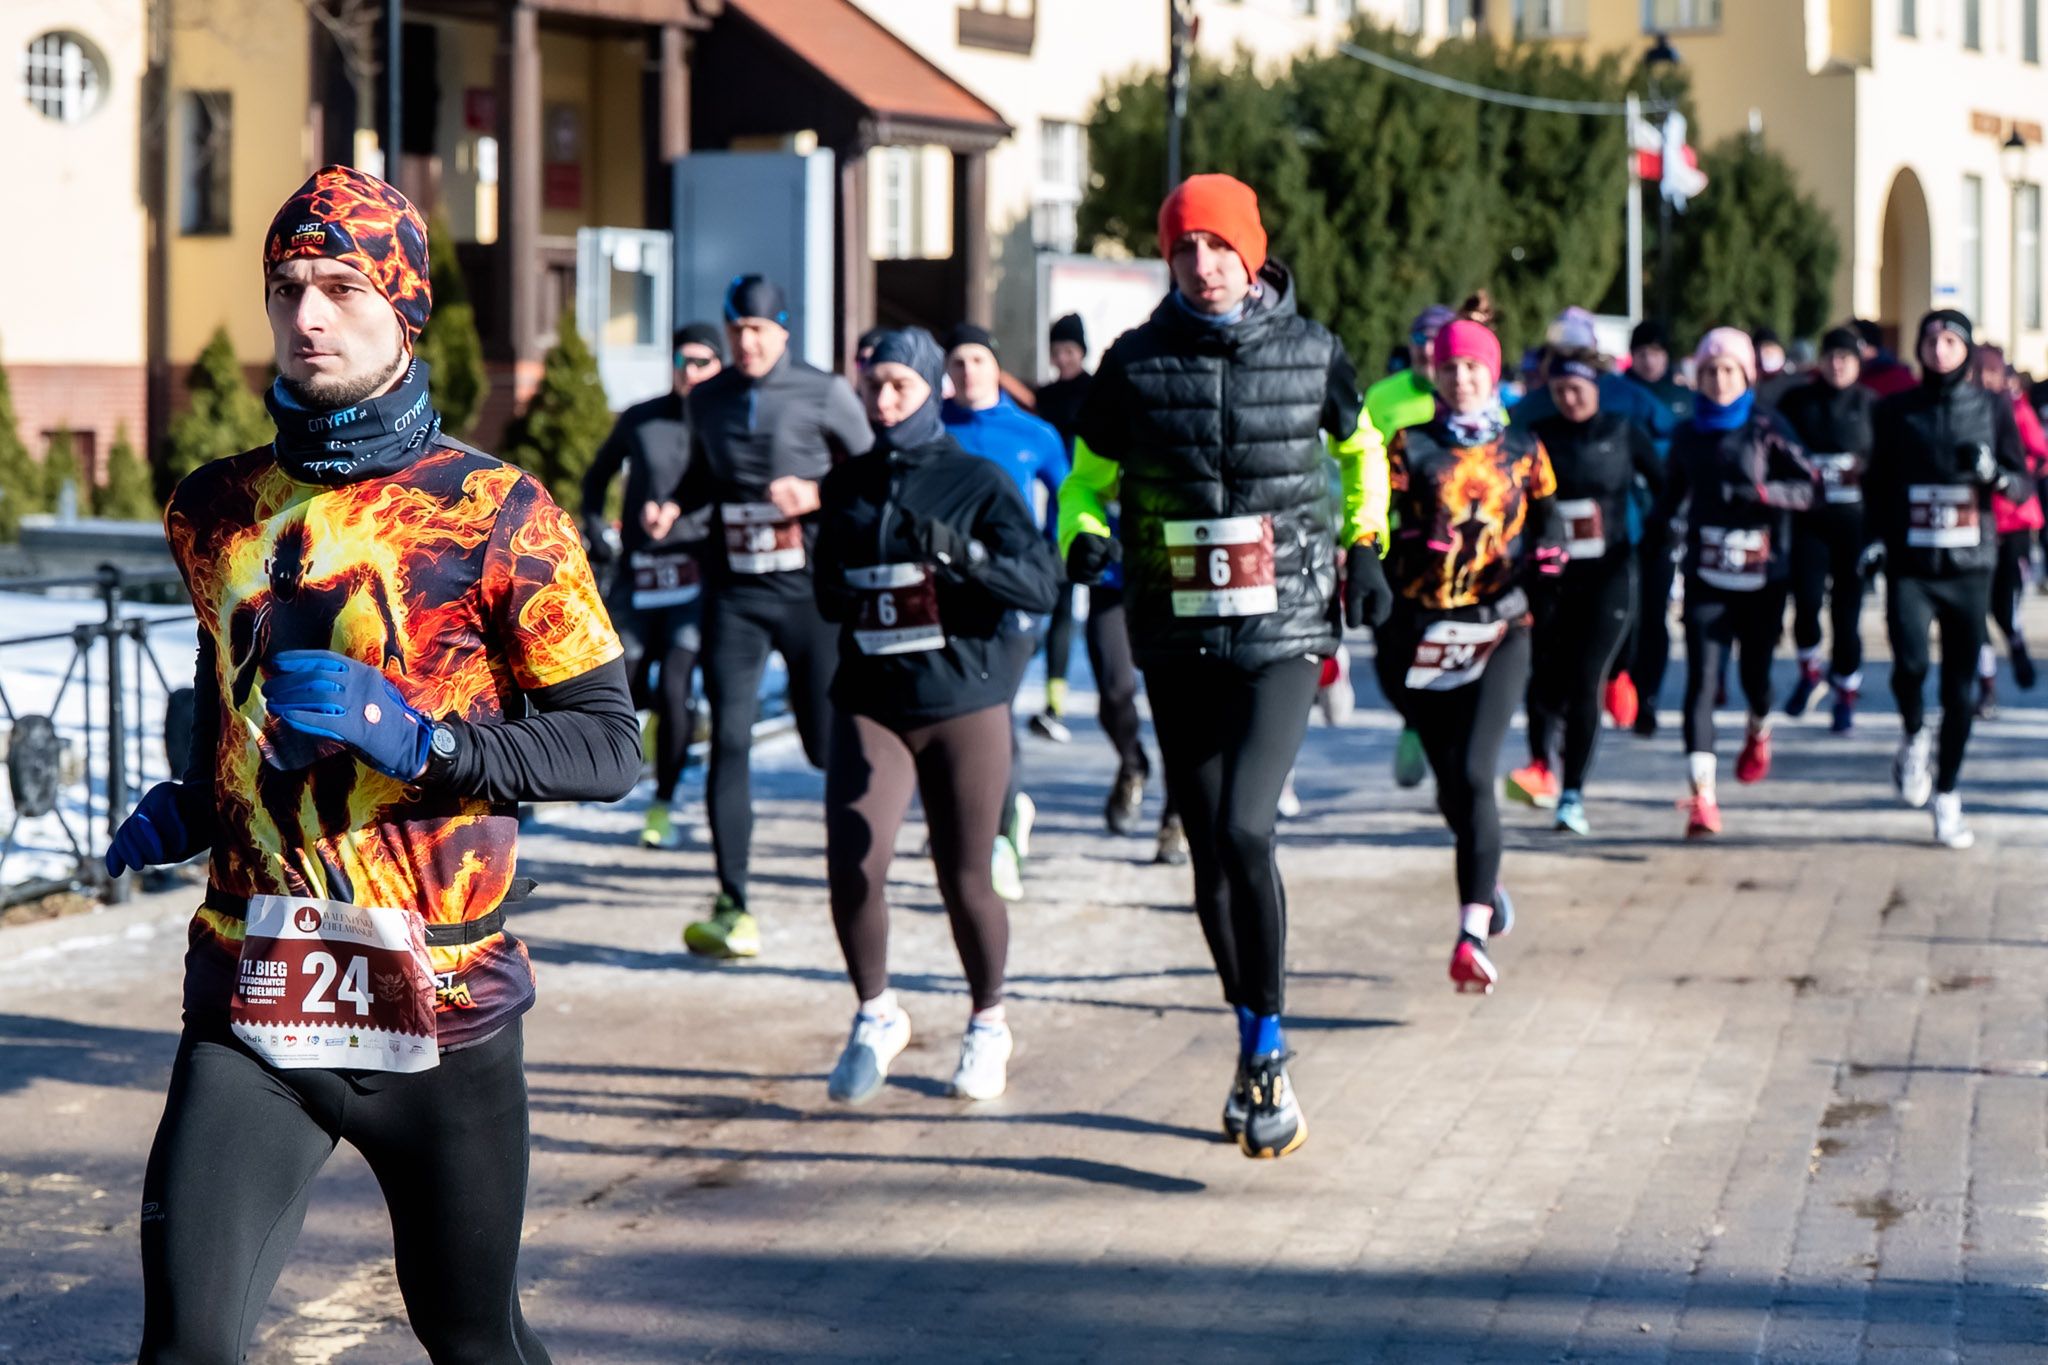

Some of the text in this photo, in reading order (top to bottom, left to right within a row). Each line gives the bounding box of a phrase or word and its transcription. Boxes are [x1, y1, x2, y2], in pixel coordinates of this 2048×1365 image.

[296, 222, 322, 233] JUST
[293, 232, 324, 245] HERO
[1209, 547, 1232, 587] 6
[878, 591, 898, 627] 6
[240, 975, 286, 987] ZAKOCHANYCH
[301, 951, 375, 1016] 24
[239, 984, 246, 995] W
